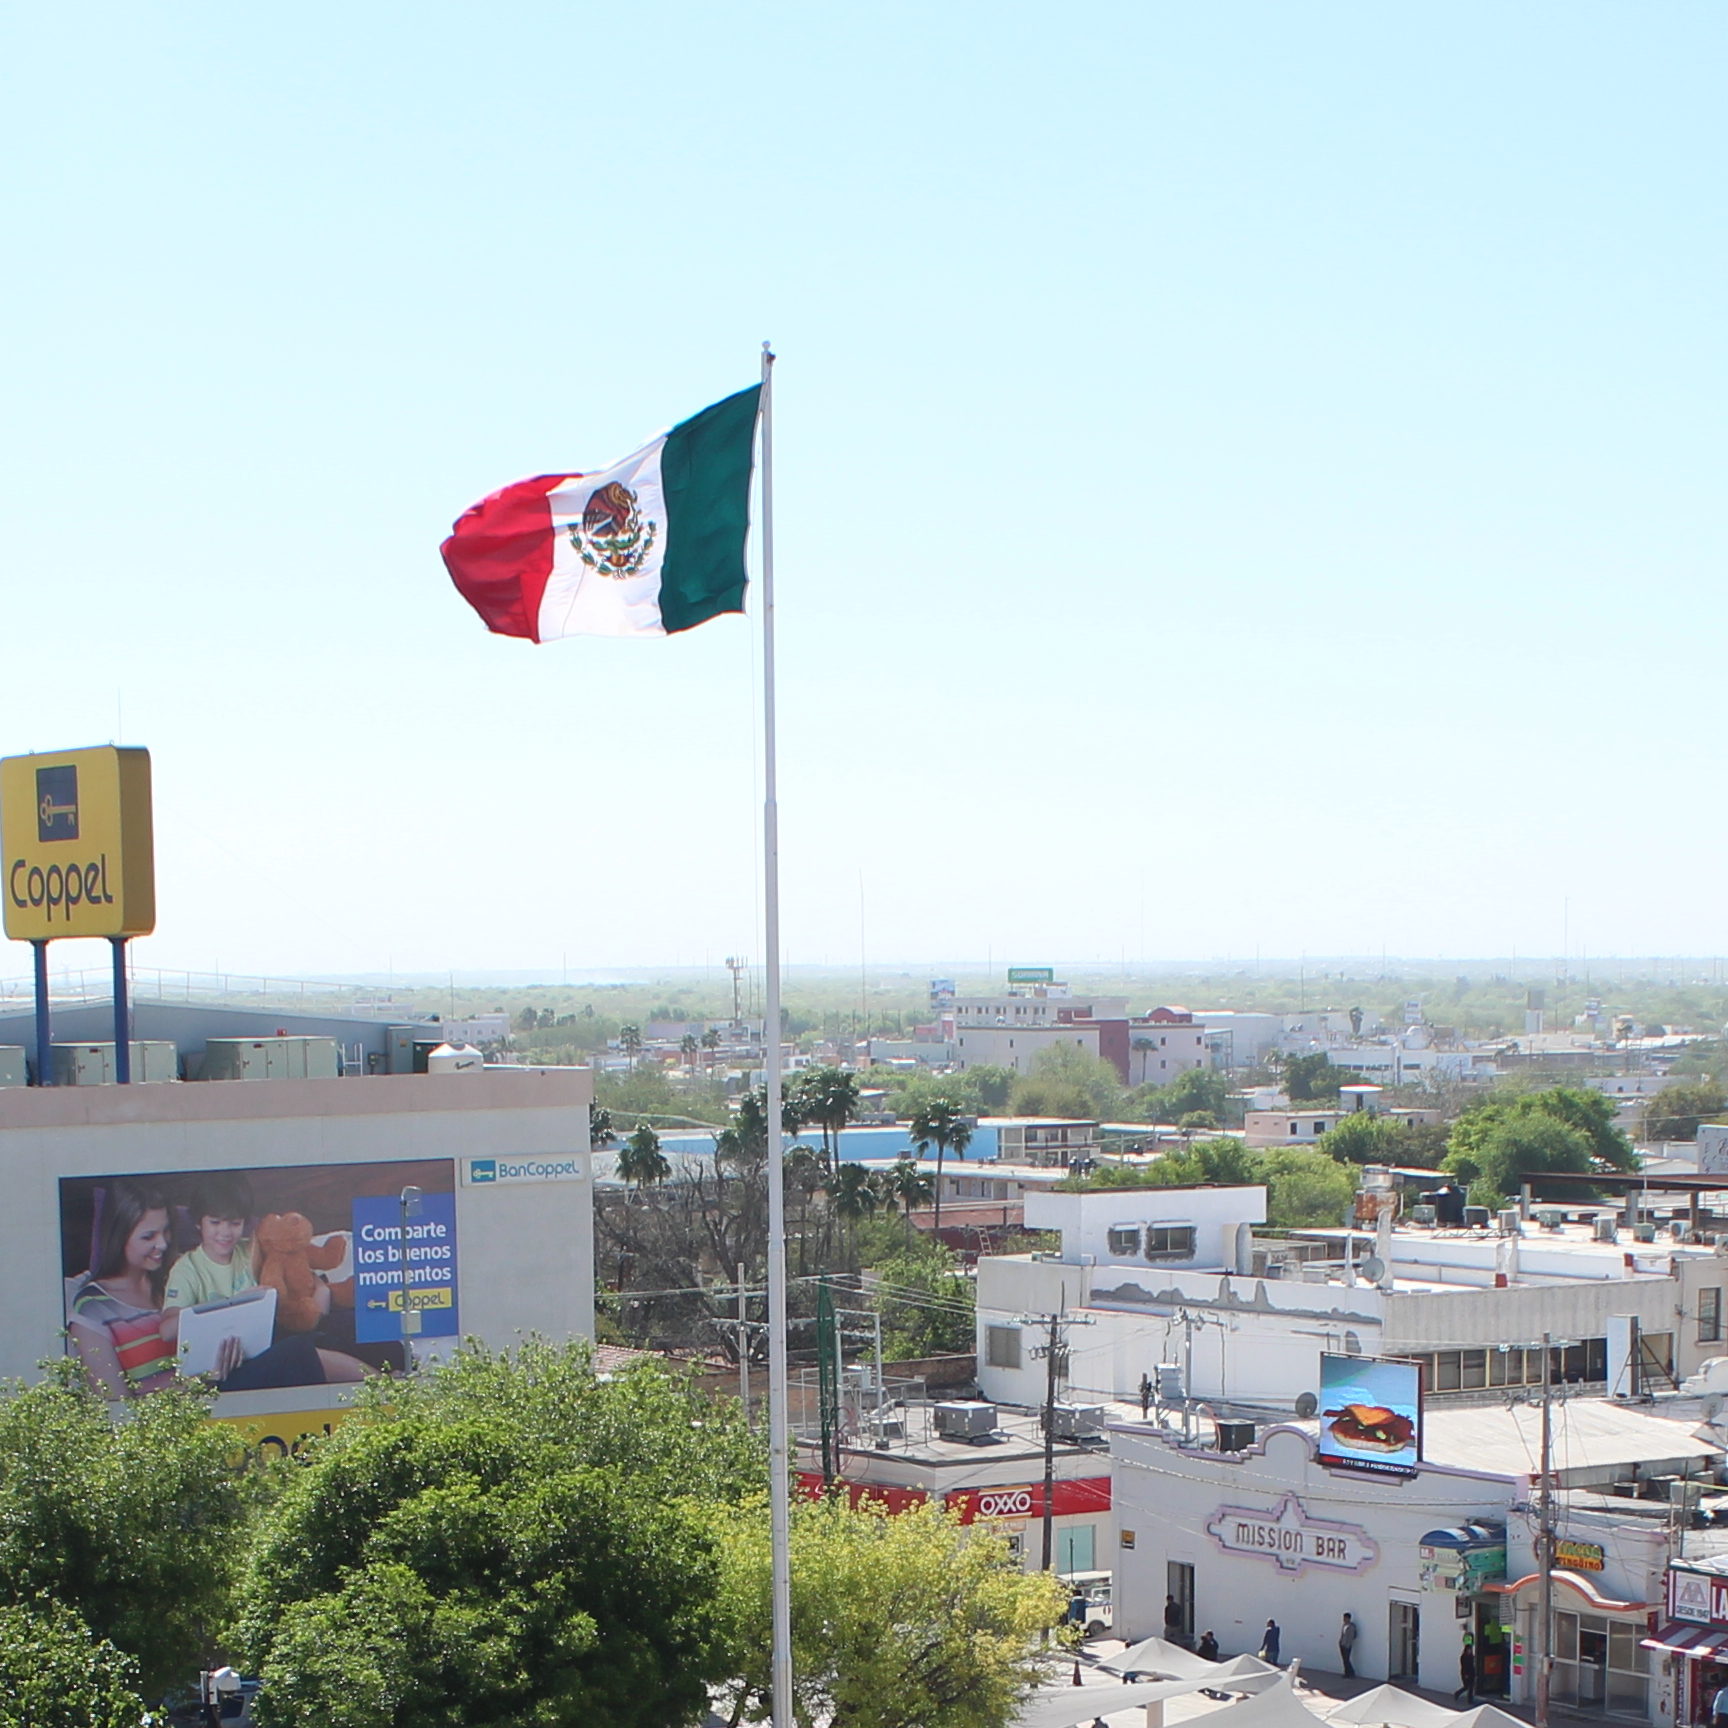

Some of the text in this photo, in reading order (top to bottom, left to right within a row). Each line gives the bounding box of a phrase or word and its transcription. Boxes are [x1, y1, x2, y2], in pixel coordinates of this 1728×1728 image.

[10, 853, 114, 922] Coppel
[499, 1160, 580, 1179] BanCoppel
[358, 1247, 385, 1264] los
[980, 1490, 1031, 1516] OXXO
[1315, 1536, 1348, 1560] BAR
